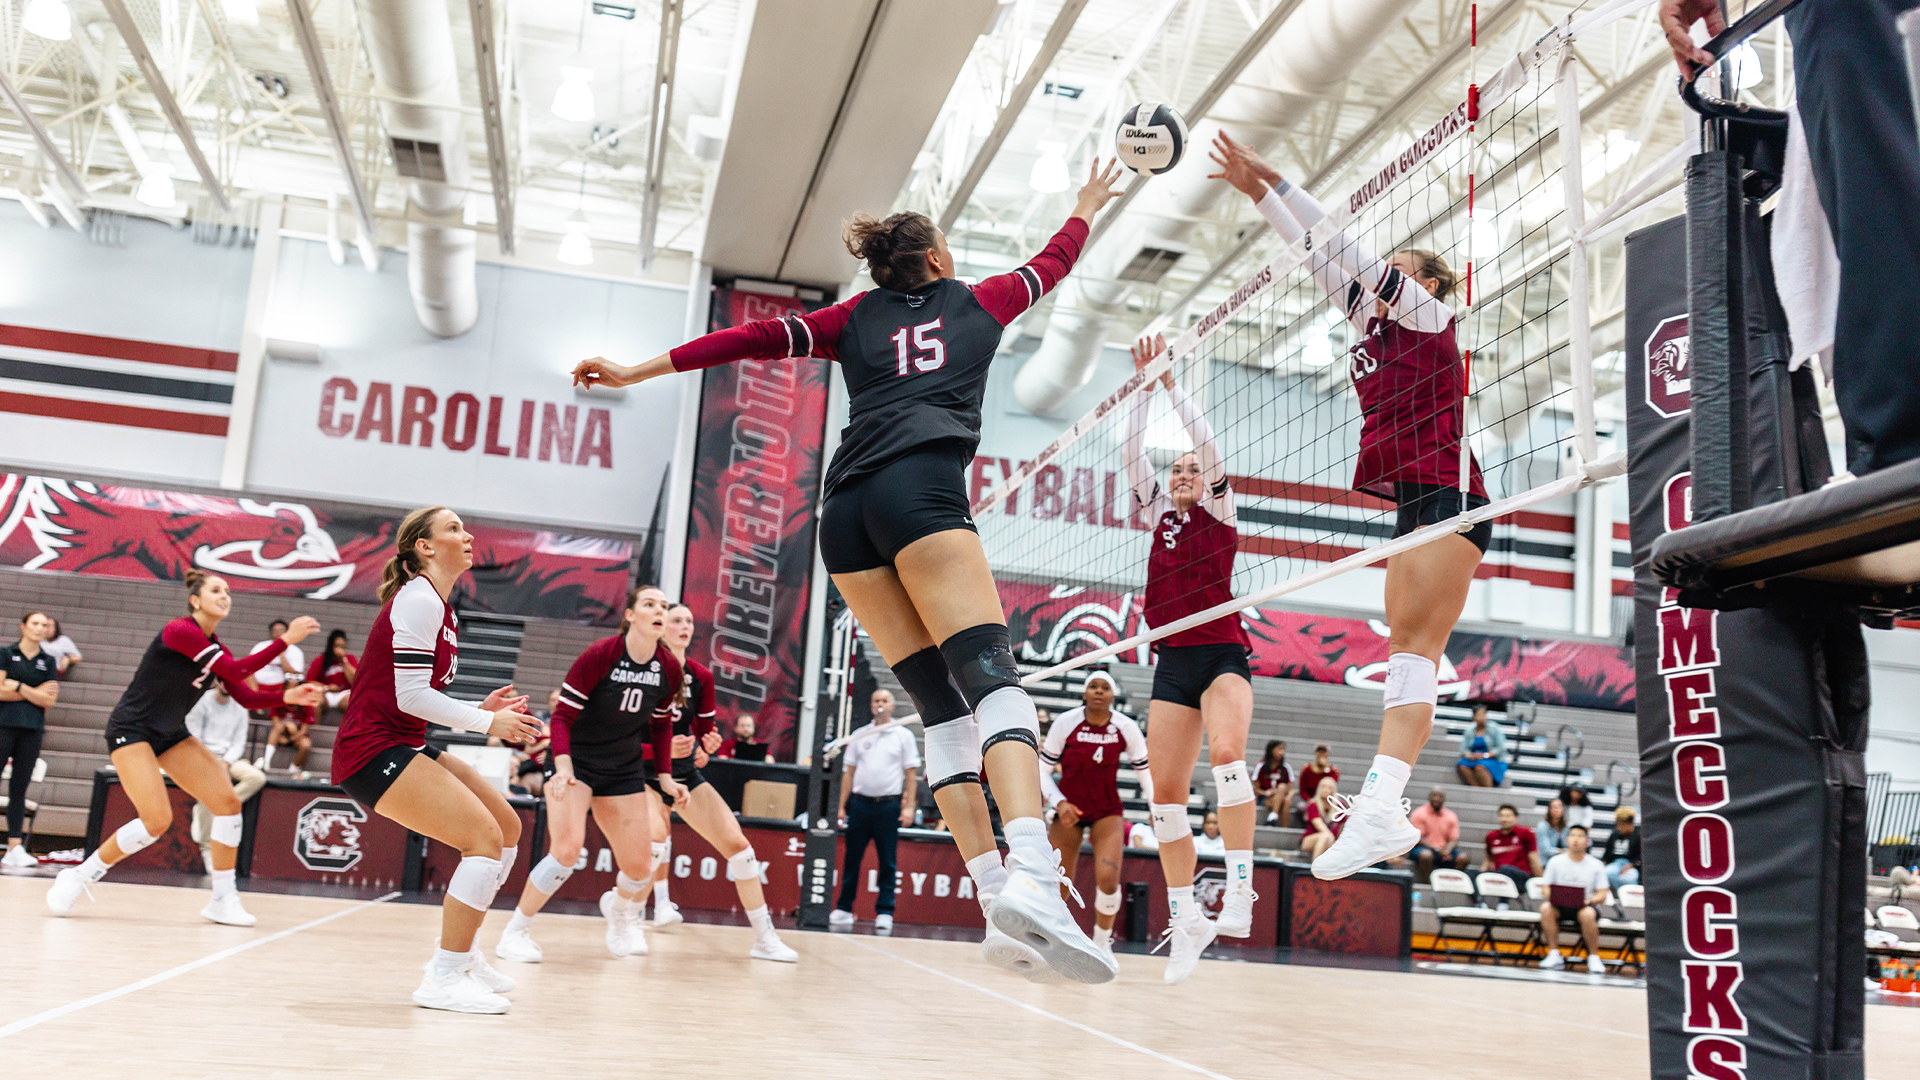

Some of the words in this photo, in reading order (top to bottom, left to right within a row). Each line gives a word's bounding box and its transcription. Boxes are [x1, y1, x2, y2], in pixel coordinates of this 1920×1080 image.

[1125, 128, 1158, 139] Wilson
[1350, 160, 1397, 214] CAROLINA
[1399, 101, 1466, 174] GAMECOCKS
[890, 315, 947, 377] 15
[317, 376, 613, 469] CAROLINA
[729, 414, 791, 483] TO
[709, 482, 784, 703] FOREVER
[619, 687, 644, 713] 10
[1092, 746, 1104, 764] 4
[1656, 471, 1749, 1080] MECOCKS
[574, 846, 771, 885] GACOK
